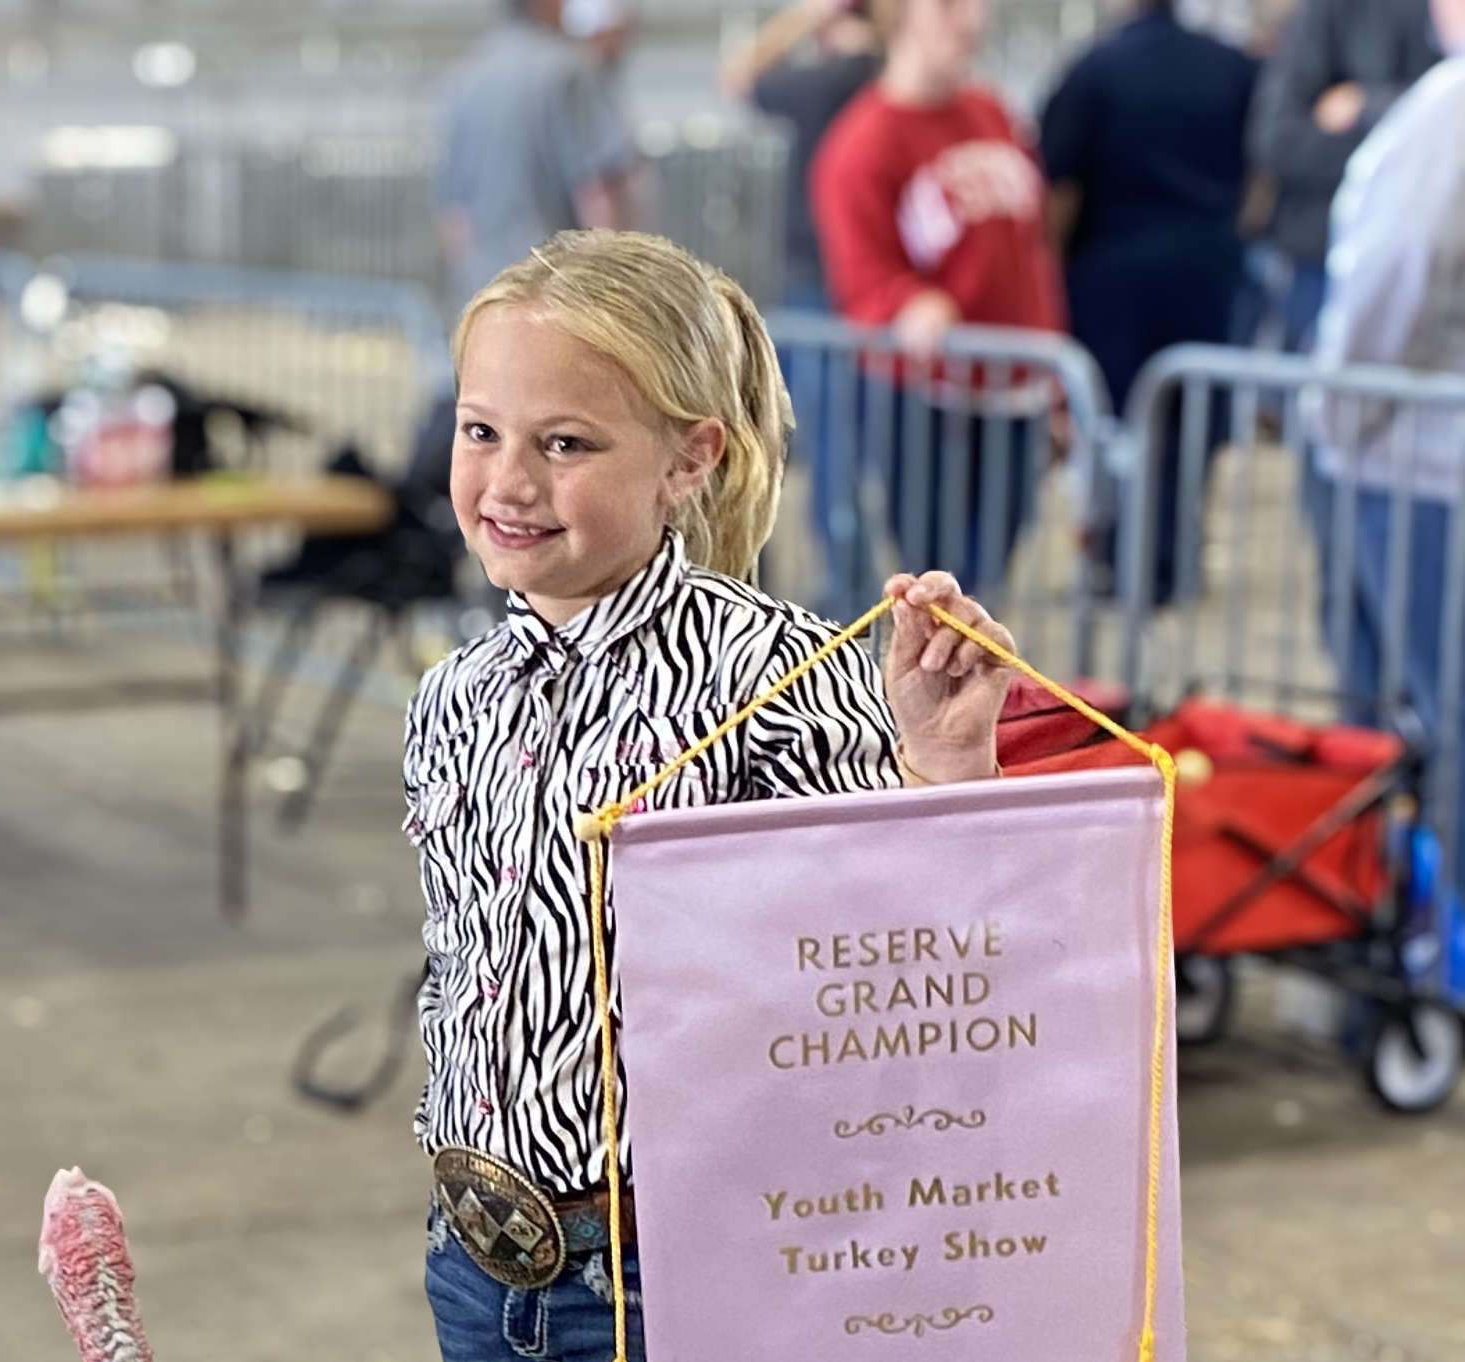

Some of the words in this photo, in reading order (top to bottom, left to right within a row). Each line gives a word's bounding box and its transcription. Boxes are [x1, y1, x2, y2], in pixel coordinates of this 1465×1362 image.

[797, 920, 1003, 971] RESERVE
[815, 971, 992, 1018] GRAND
[768, 1013, 1037, 1070] CHAMPION
[763, 1183, 885, 1221] Youth
[908, 1171, 1062, 1209] Market
[779, 1241, 920, 1275] Turkey
[943, 1231, 1048, 1262] Show
